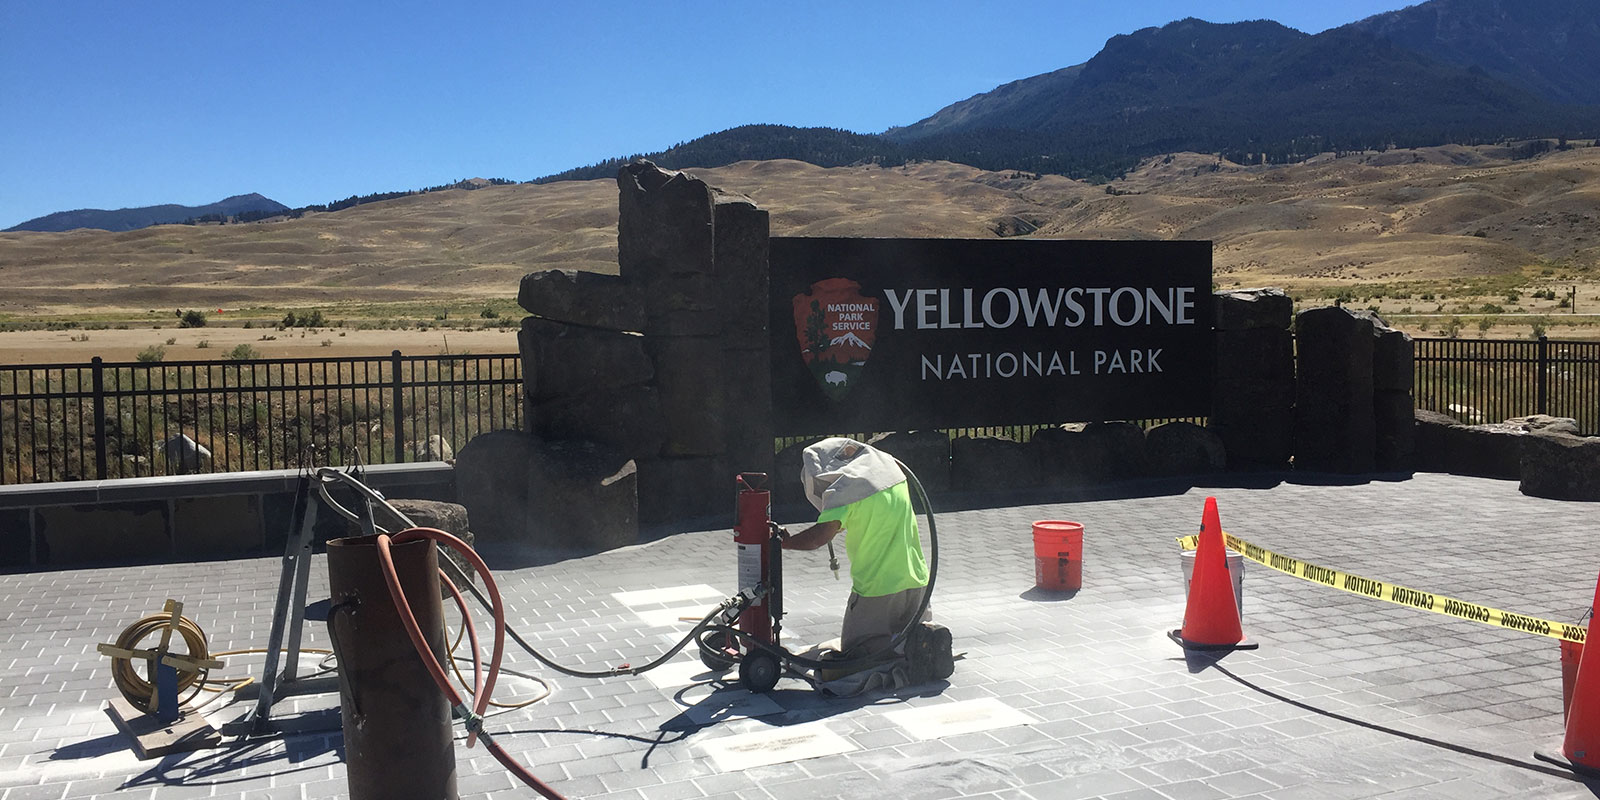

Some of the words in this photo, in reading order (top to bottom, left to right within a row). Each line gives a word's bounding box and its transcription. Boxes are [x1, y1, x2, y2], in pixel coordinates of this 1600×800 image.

[827, 303, 875, 312] NATIONAL
[883, 286, 1195, 330] YELLOWSTONE
[839, 312, 864, 321] PARK
[832, 321, 871, 331] SERVICE
[920, 350, 1081, 380] NATIONAL
[1093, 348, 1163, 375] PARK
